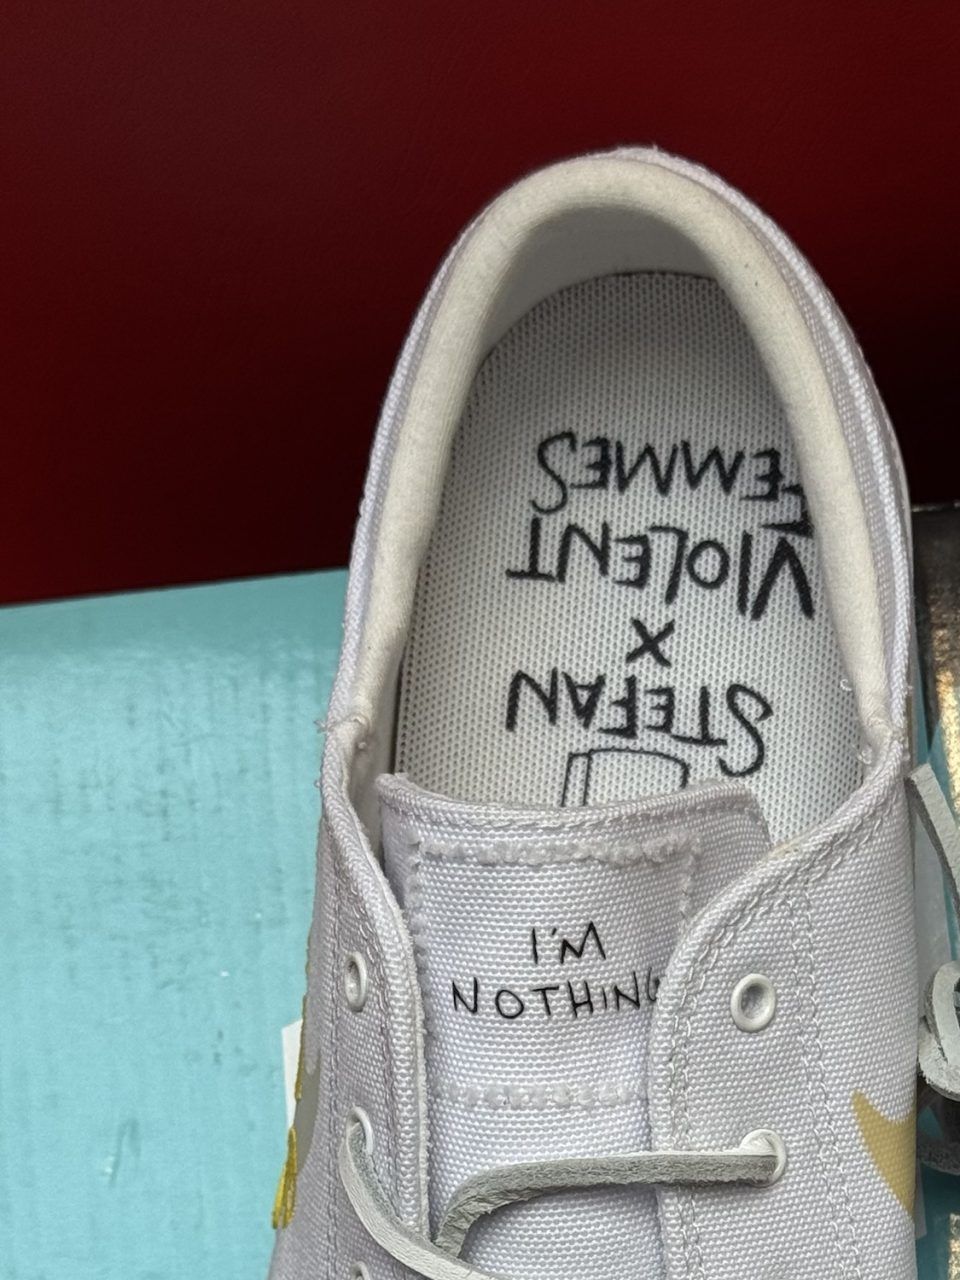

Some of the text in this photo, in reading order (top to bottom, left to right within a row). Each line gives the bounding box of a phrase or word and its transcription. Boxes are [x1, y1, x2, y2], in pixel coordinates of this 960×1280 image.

[505, 517, 815, 620] VIOLENT
[505, 667, 774, 778] STEFAN
[531, 920, 606, 965] I'M
